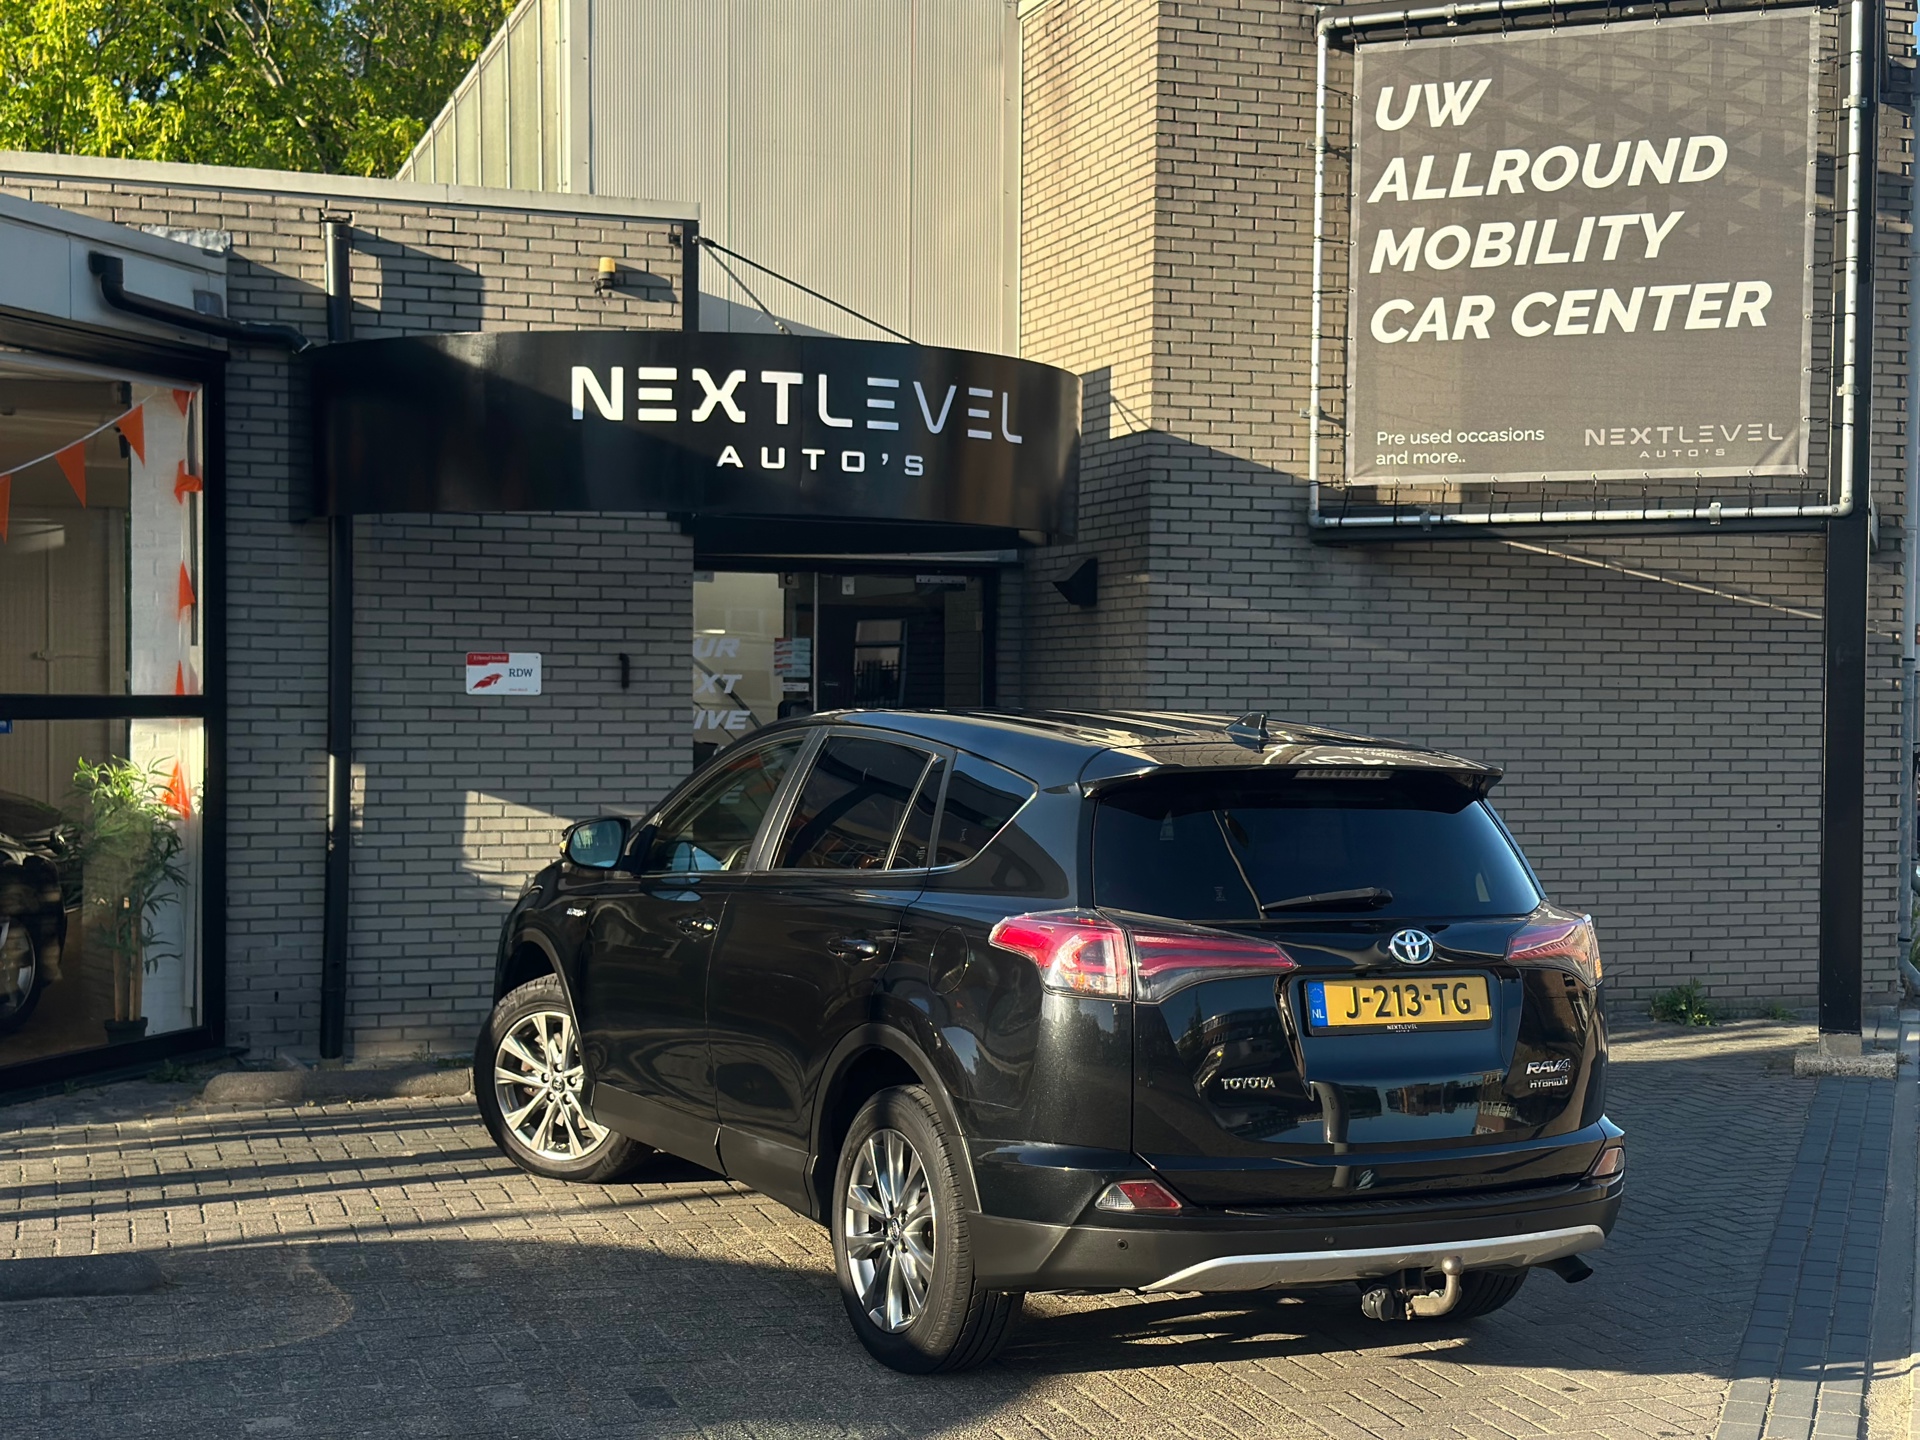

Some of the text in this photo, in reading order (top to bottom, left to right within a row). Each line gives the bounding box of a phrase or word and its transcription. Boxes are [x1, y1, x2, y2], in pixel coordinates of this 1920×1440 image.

[1375, 79, 1492, 131] UW
[1367, 135, 1729, 203] ALLROUND
[1369, 211, 1686, 273] MOBILITY
[1370, 281, 1773, 343] CAR CENTER
[1376, 427, 1545, 446] Pre used occasions
[716, 445, 924, 476] AUTO'S
[1376, 451, 1466, 465] and more..
[1639, 448, 1726, 458] AUTO'S
[508, 668, 533, 678] RDW
[1346, 983, 1472, 1018] J-213-TG
[1311, 1008, 1326, 1020] NL
[1526, 1058, 1571, 1075] RAV4
[1221, 1076, 1276, 1090] TOYOTA
